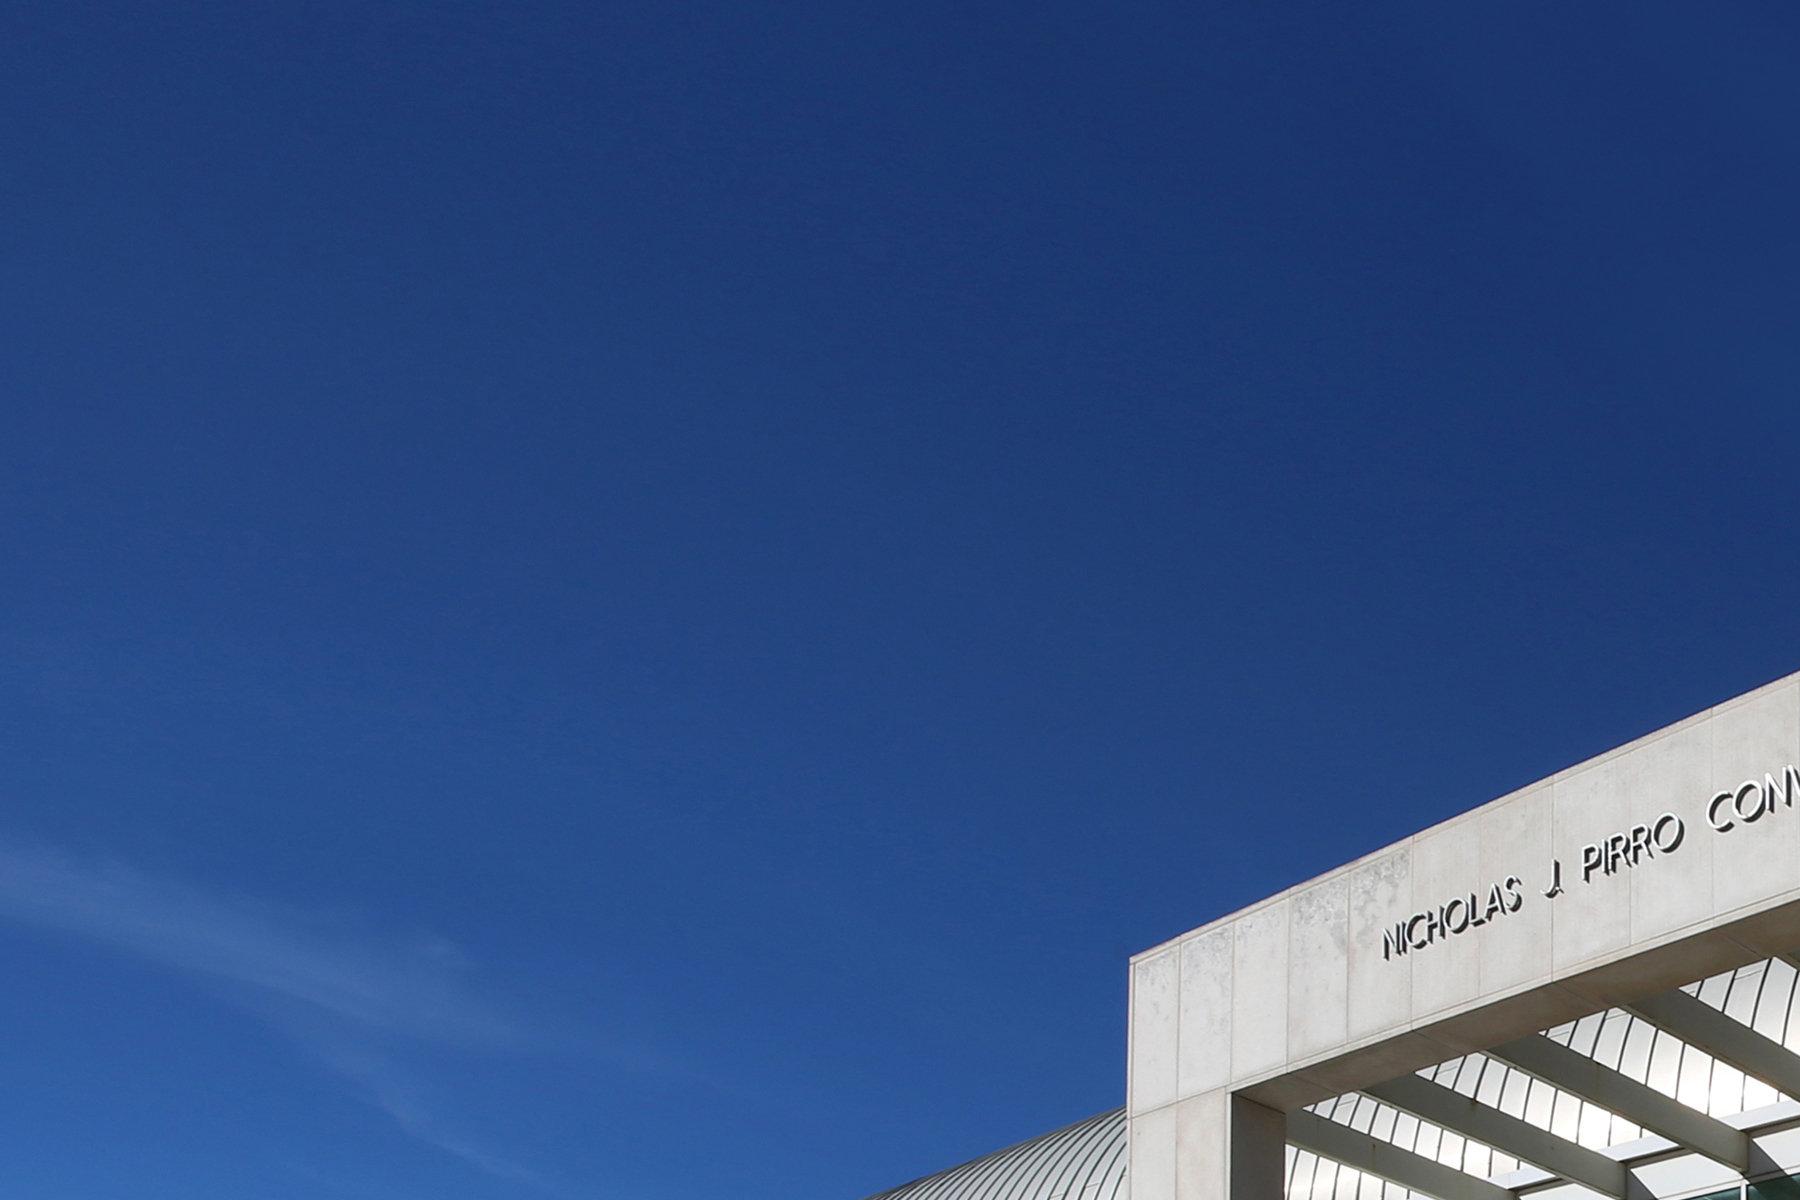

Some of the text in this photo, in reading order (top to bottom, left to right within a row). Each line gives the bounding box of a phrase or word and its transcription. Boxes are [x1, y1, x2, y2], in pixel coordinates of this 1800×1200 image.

[1382, 875, 1523, 961] NICHOLAS
[1540, 858, 1565, 899] J.
[1582, 812, 1686, 883] PIRRO
